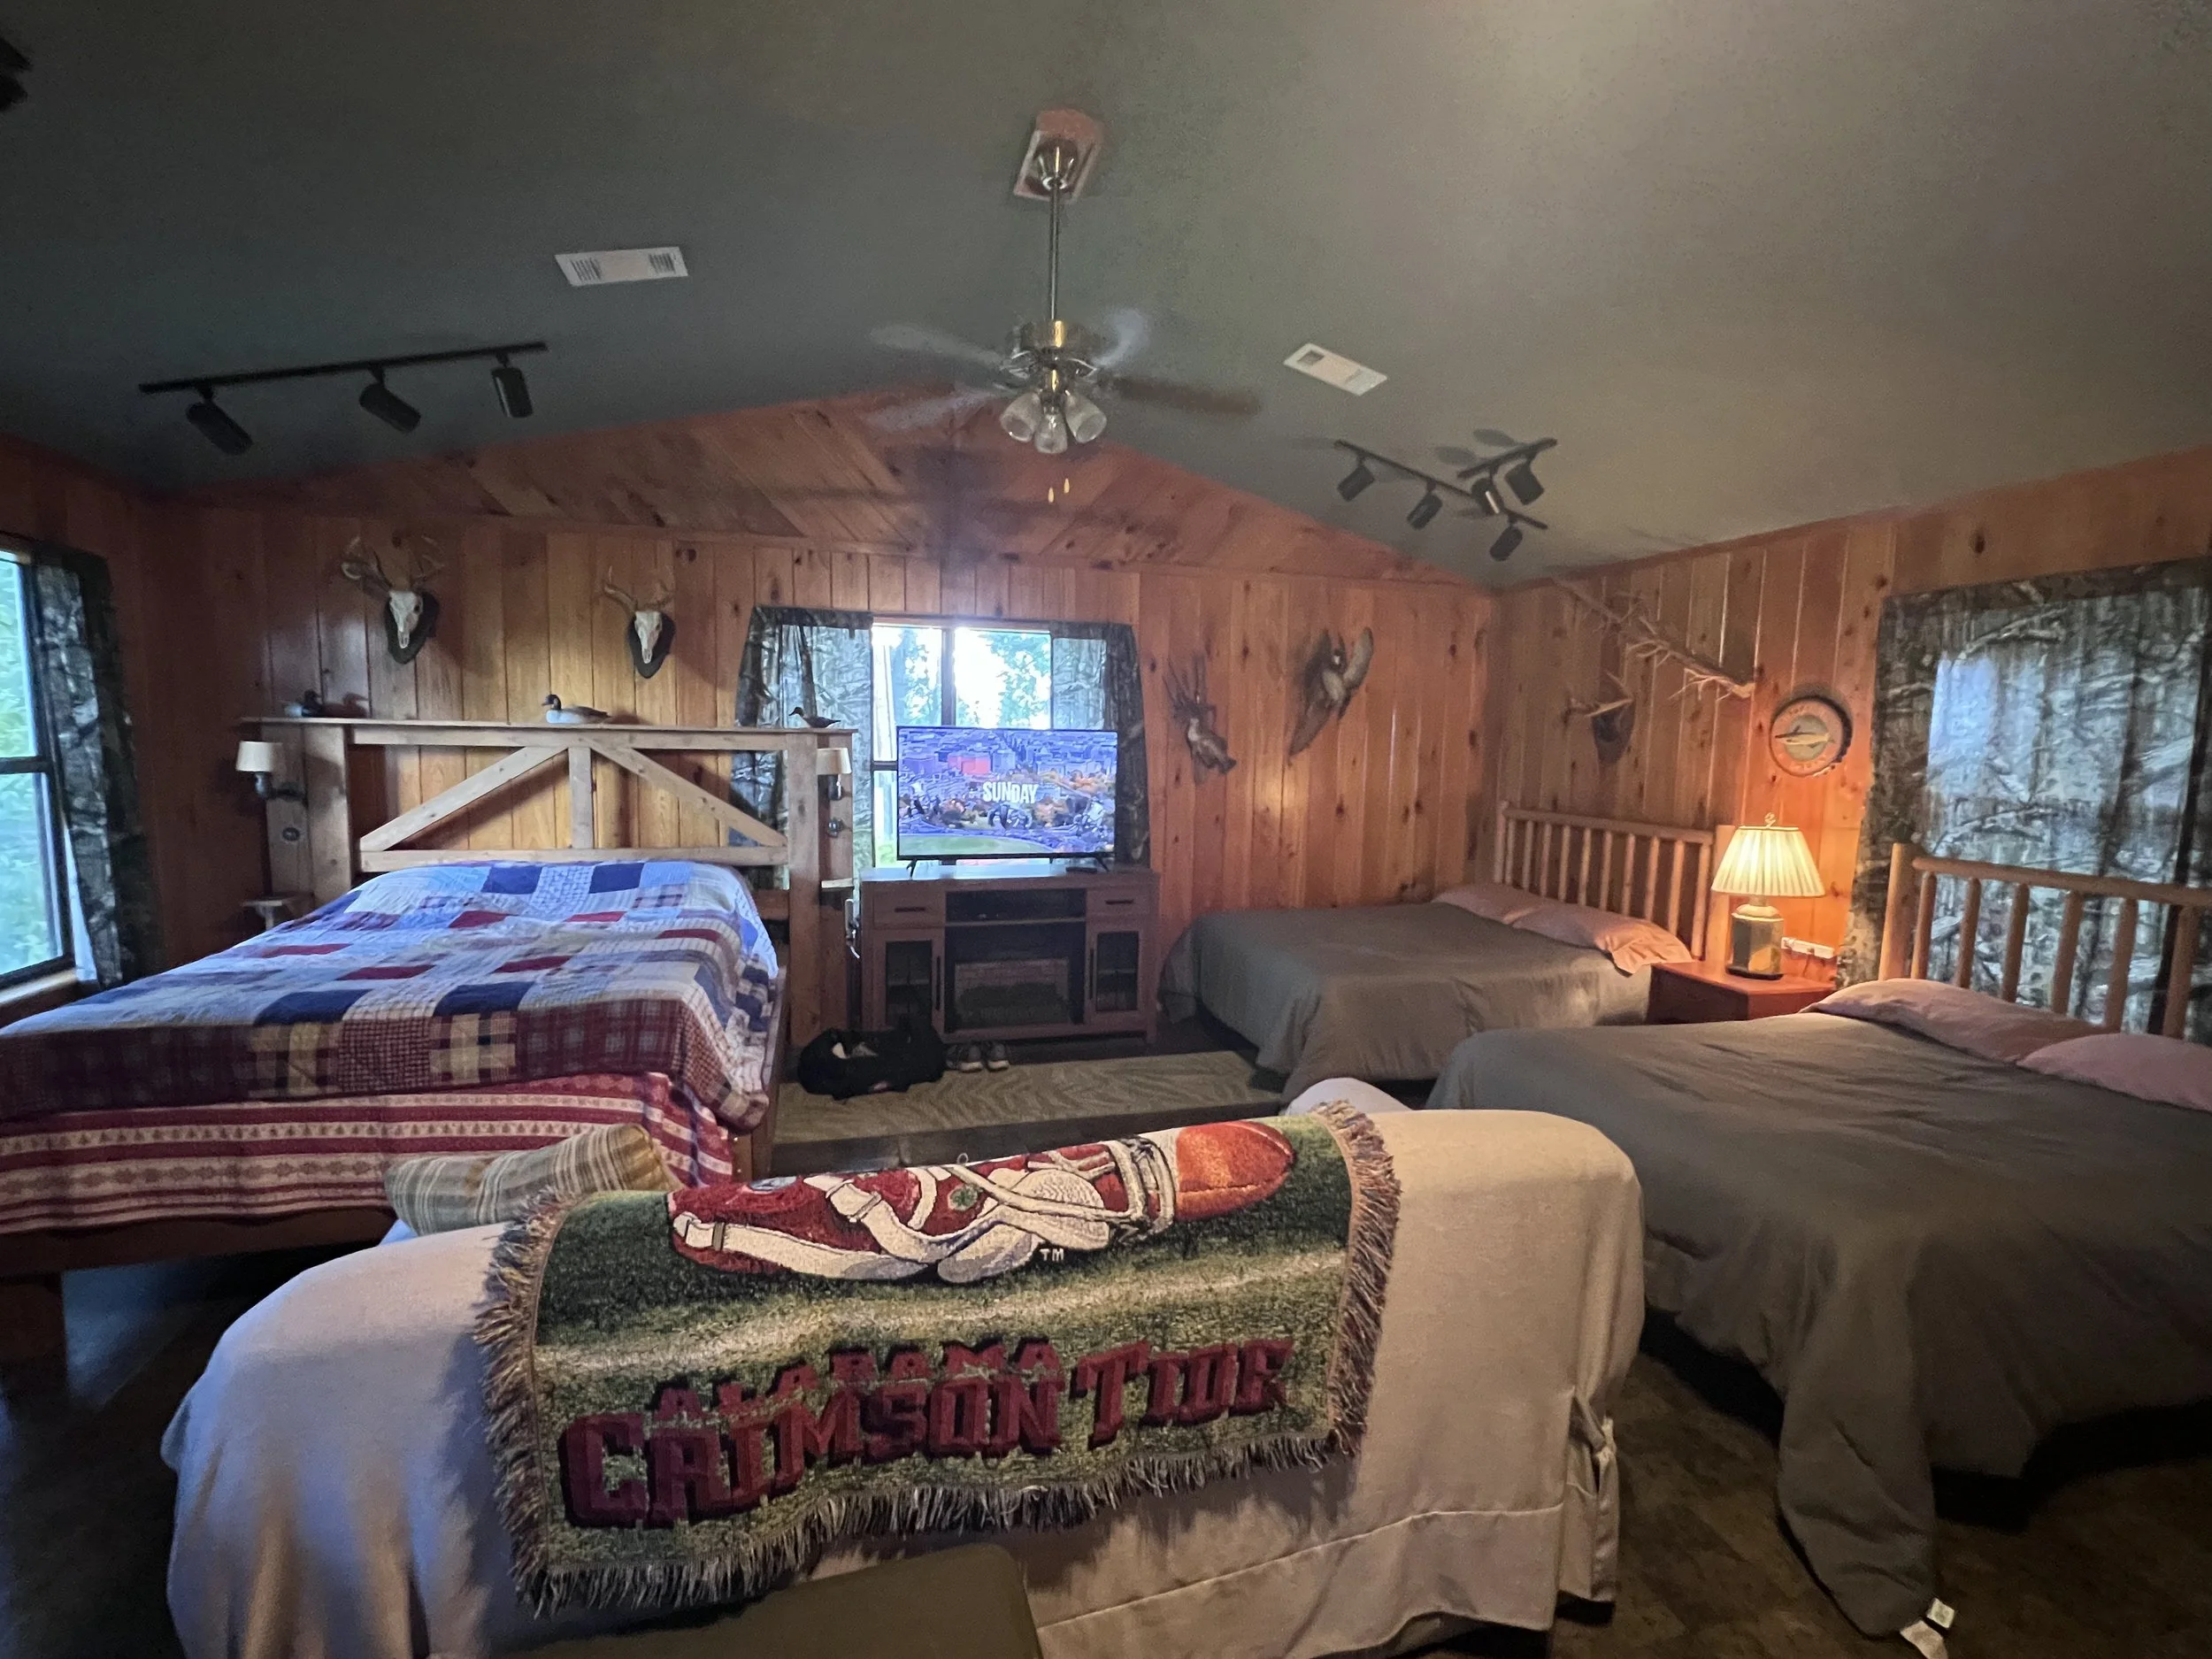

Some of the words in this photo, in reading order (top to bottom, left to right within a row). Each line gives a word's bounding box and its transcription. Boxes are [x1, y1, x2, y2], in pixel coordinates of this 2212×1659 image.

[983, 781, 1039, 803] SUNDAY
[1040, 1248, 1064, 1262] TM
[557, 1368, 1065, 1528] CRIMSON
[1069, 1340, 1294, 1450] TIDE
